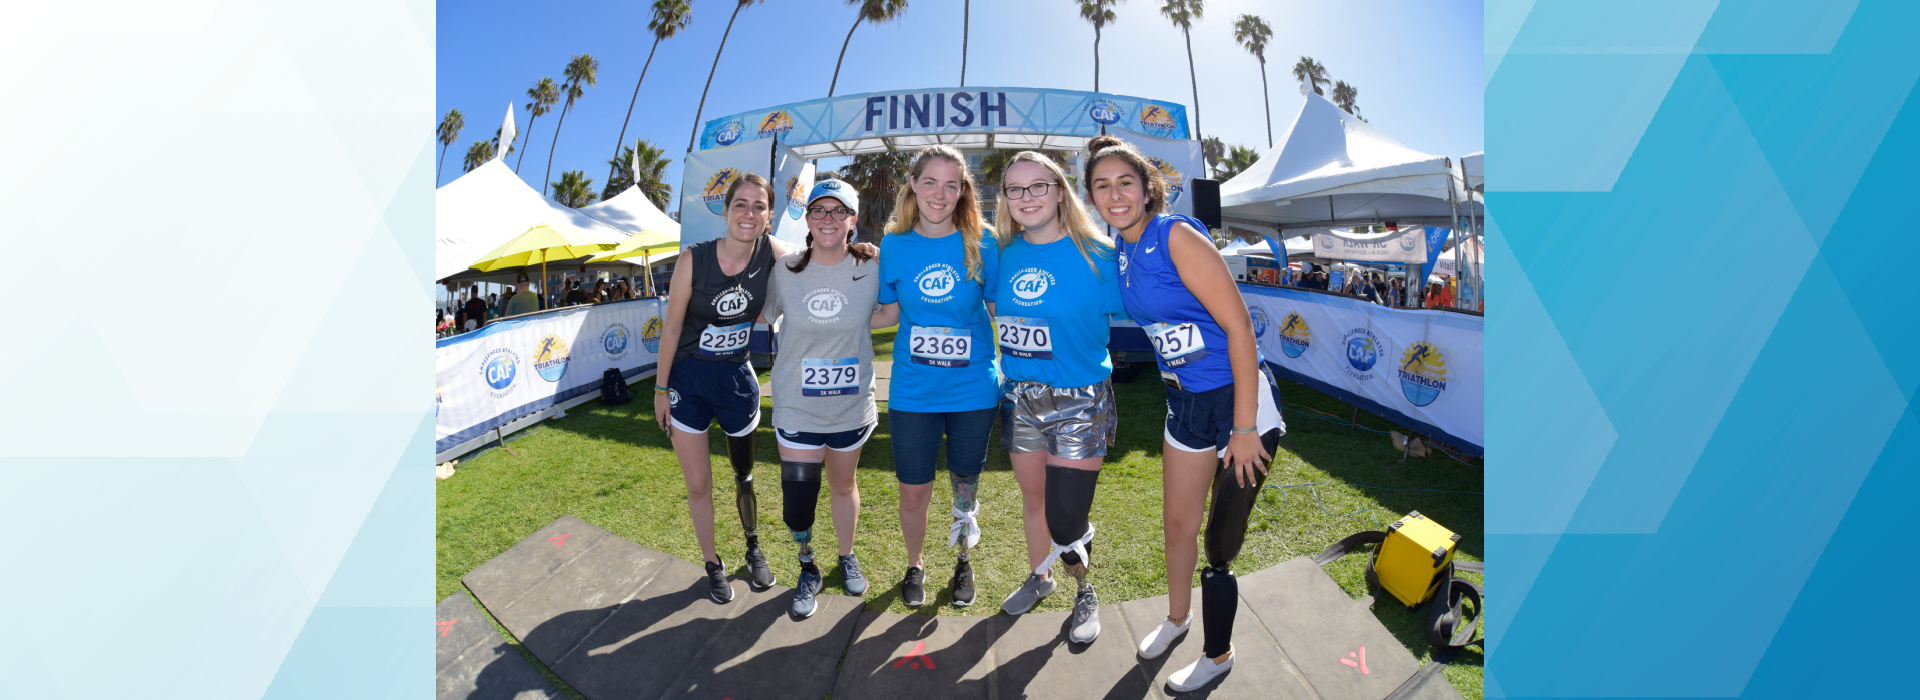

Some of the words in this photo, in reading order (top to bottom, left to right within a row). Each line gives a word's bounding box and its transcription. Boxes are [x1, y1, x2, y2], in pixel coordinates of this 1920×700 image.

[865, 92, 1007, 131] FINISH
[1092, 109, 1117, 121] CAF
[757, 125, 794, 136] TRIATHLON
[1139, 120, 1175, 130] TRIATHLON
[718, 131, 738, 142] CAF
[702, 193, 725, 202] TRIAT
[914, 263, 941, 283] CHALLENGED
[942, 263, 961, 282] ATHLETES
[1009, 268, 1037, 284] CHALLENGED
[1038, 268, 1056, 286] ATHLETES
[922, 277, 950, 290] CAF
[1016, 279, 1043, 292] CAF
[711, 286, 734, 306] CHALLENGED
[719, 298, 745, 312] CAF
[802, 288, 829, 303] CHALLENGED
[830, 287, 849, 305] ATHLETES
[810, 299, 839, 312] CAF
[606, 335, 625, 351] CAF
[641, 335, 661, 344] TRIATH
[702, 330, 748, 349] 2259
[999, 323, 1048, 347] 2370
[1150, 325, 1193, 355] 257
[1341, 327, 1366, 346] CHALLENGED
[1366, 329, 1384, 358] ATHLETES
[913, 336, 968, 356] 2369
[1348, 343, 1375, 364] CAF
[479, 347, 502, 376] CHALLENGED
[502, 347, 521, 365] ATHLETES
[533, 355, 571, 371] TRIATHLON
[1171, 357, 1186, 367] WALK
[487, 362, 512, 384] CAF
[804, 366, 856, 385] 2379
[1397, 369, 1446, 391] TRIATHLON
[1404, 381, 1435, 396] CHALLENGE
